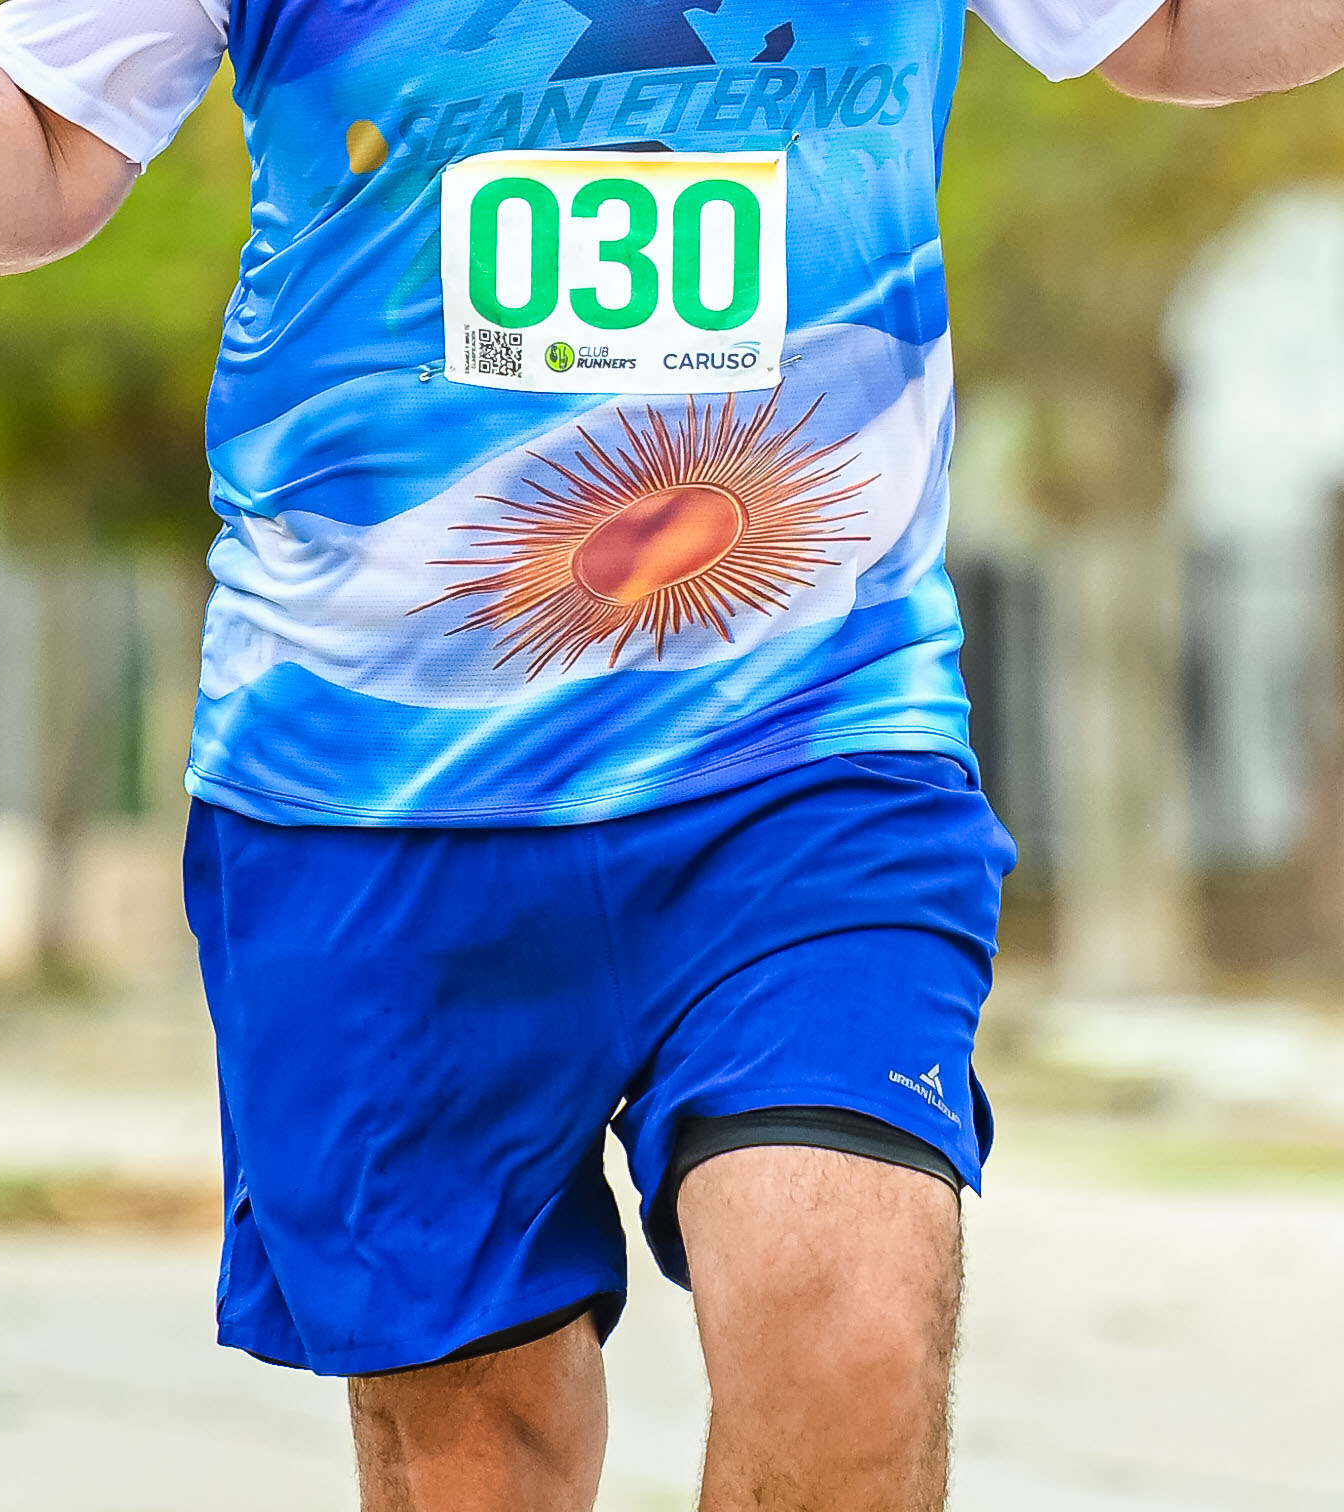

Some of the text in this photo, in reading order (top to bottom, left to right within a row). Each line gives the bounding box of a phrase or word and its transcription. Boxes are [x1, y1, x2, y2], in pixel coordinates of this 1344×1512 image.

[400, 62, 919, 161] SEAN ETERNOS
[469, 178, 760, 330] 030
[578, 346, 609, 358] CLUB
[663, 352, 757, 371] CARUSO
